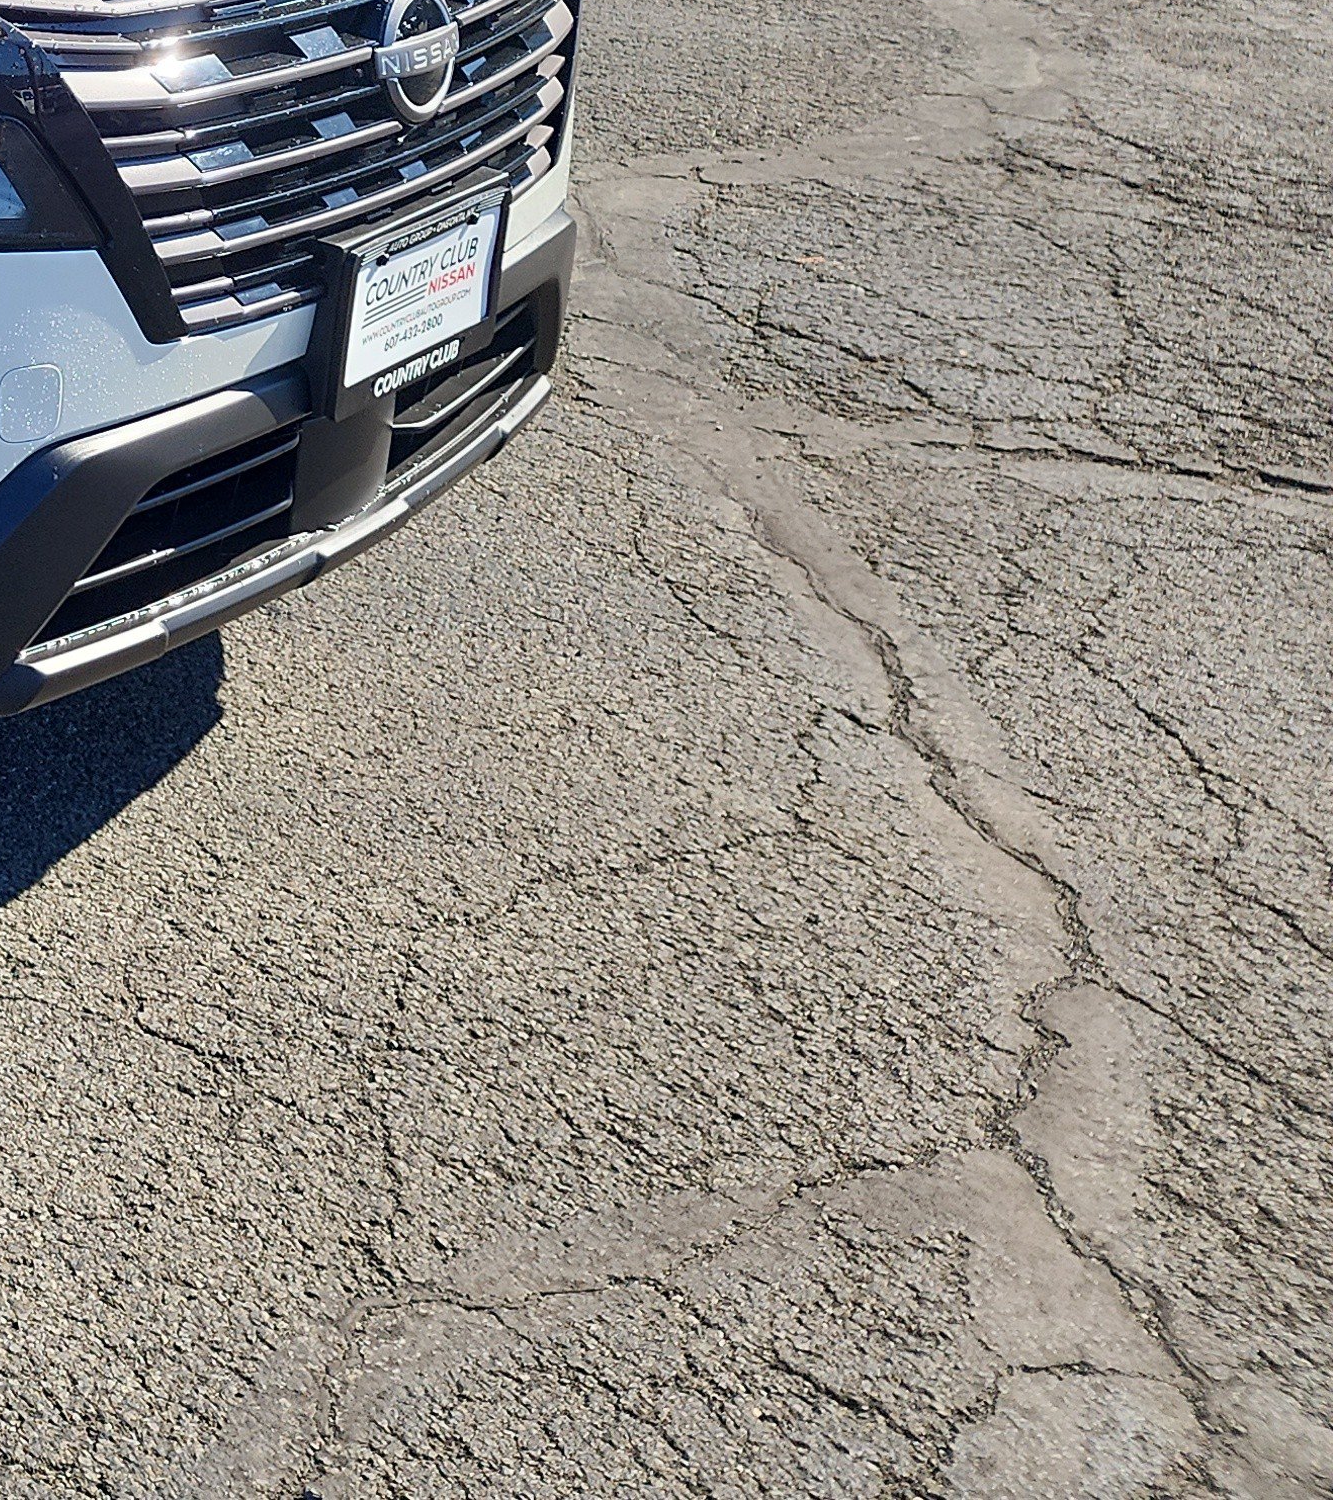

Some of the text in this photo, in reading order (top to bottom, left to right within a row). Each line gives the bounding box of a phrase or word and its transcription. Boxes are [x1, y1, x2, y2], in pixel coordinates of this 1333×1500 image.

[366, 237, 479, 306] COUNTRY CLUB
[427, 262, 476, 296] NISSAN
[384, 313, 444, 352] 607-432-2800
[374, 339, 460, 398] COUNTRY CLUB
